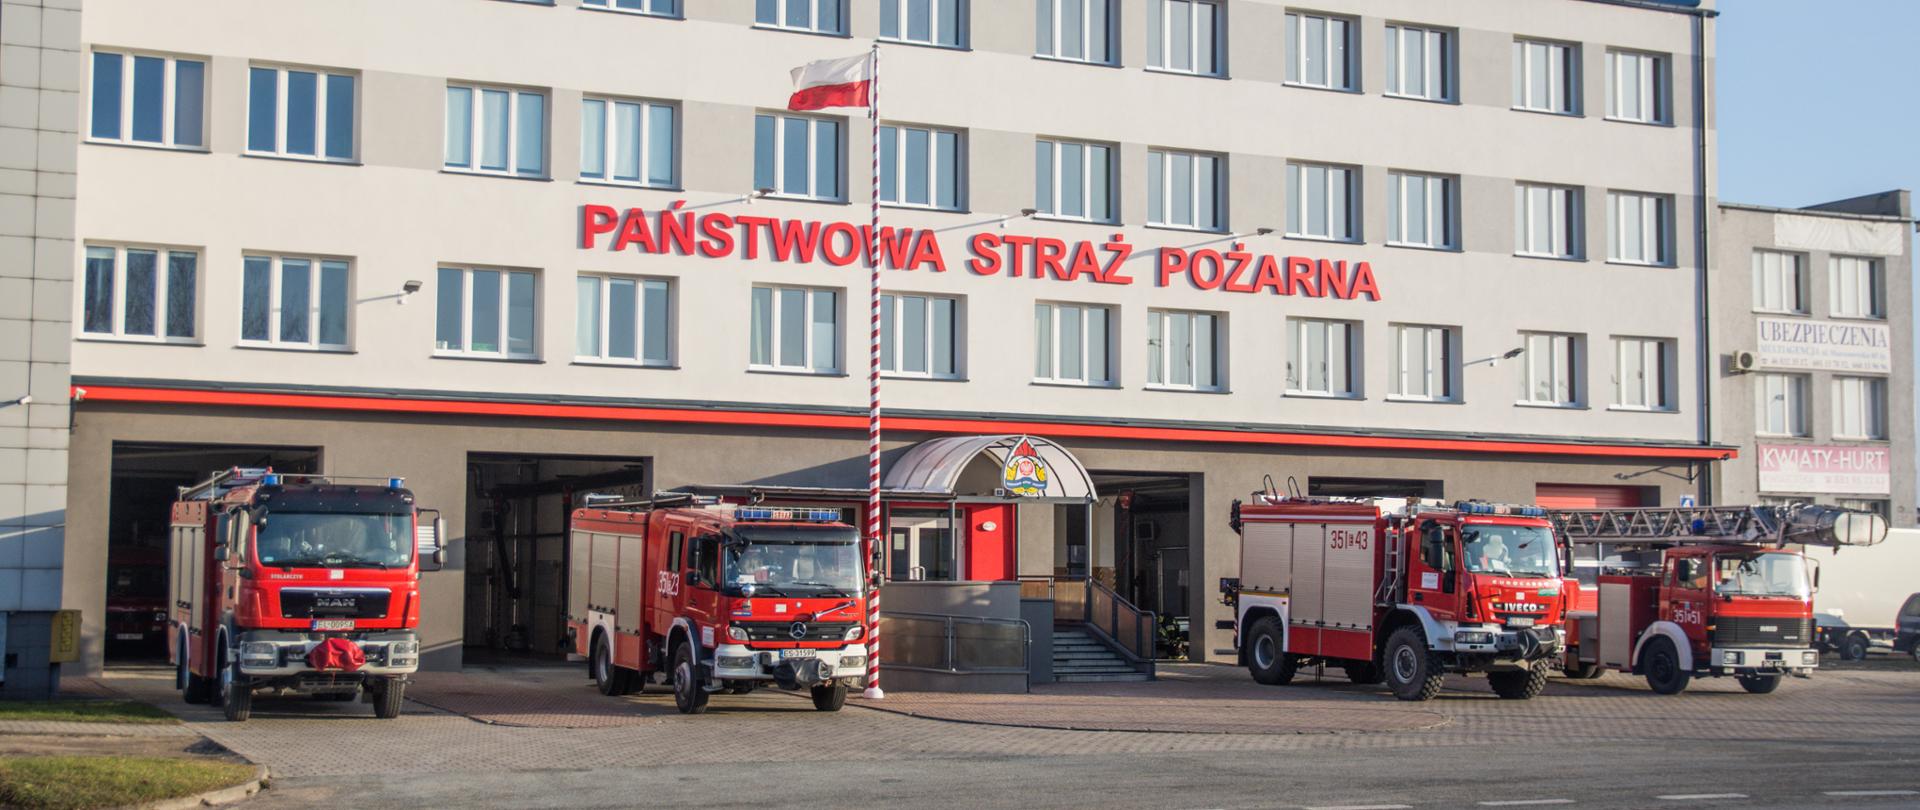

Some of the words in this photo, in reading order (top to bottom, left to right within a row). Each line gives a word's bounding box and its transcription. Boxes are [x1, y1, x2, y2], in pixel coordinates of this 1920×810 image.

[583, 200, 947, 272] PAŃSTWOWA
[970, 232, 1133, 285] STRAŻ
[1159, 242, 1382, 302] POŻARNA
[1760, 321, 1888, 348] UBEZPIECZENIA
[1763, 447, 1885, 471] KWIATY-HURT
[316, 598, 356, 607] MAN
[1503, 602, 1538, 612] IVECO
